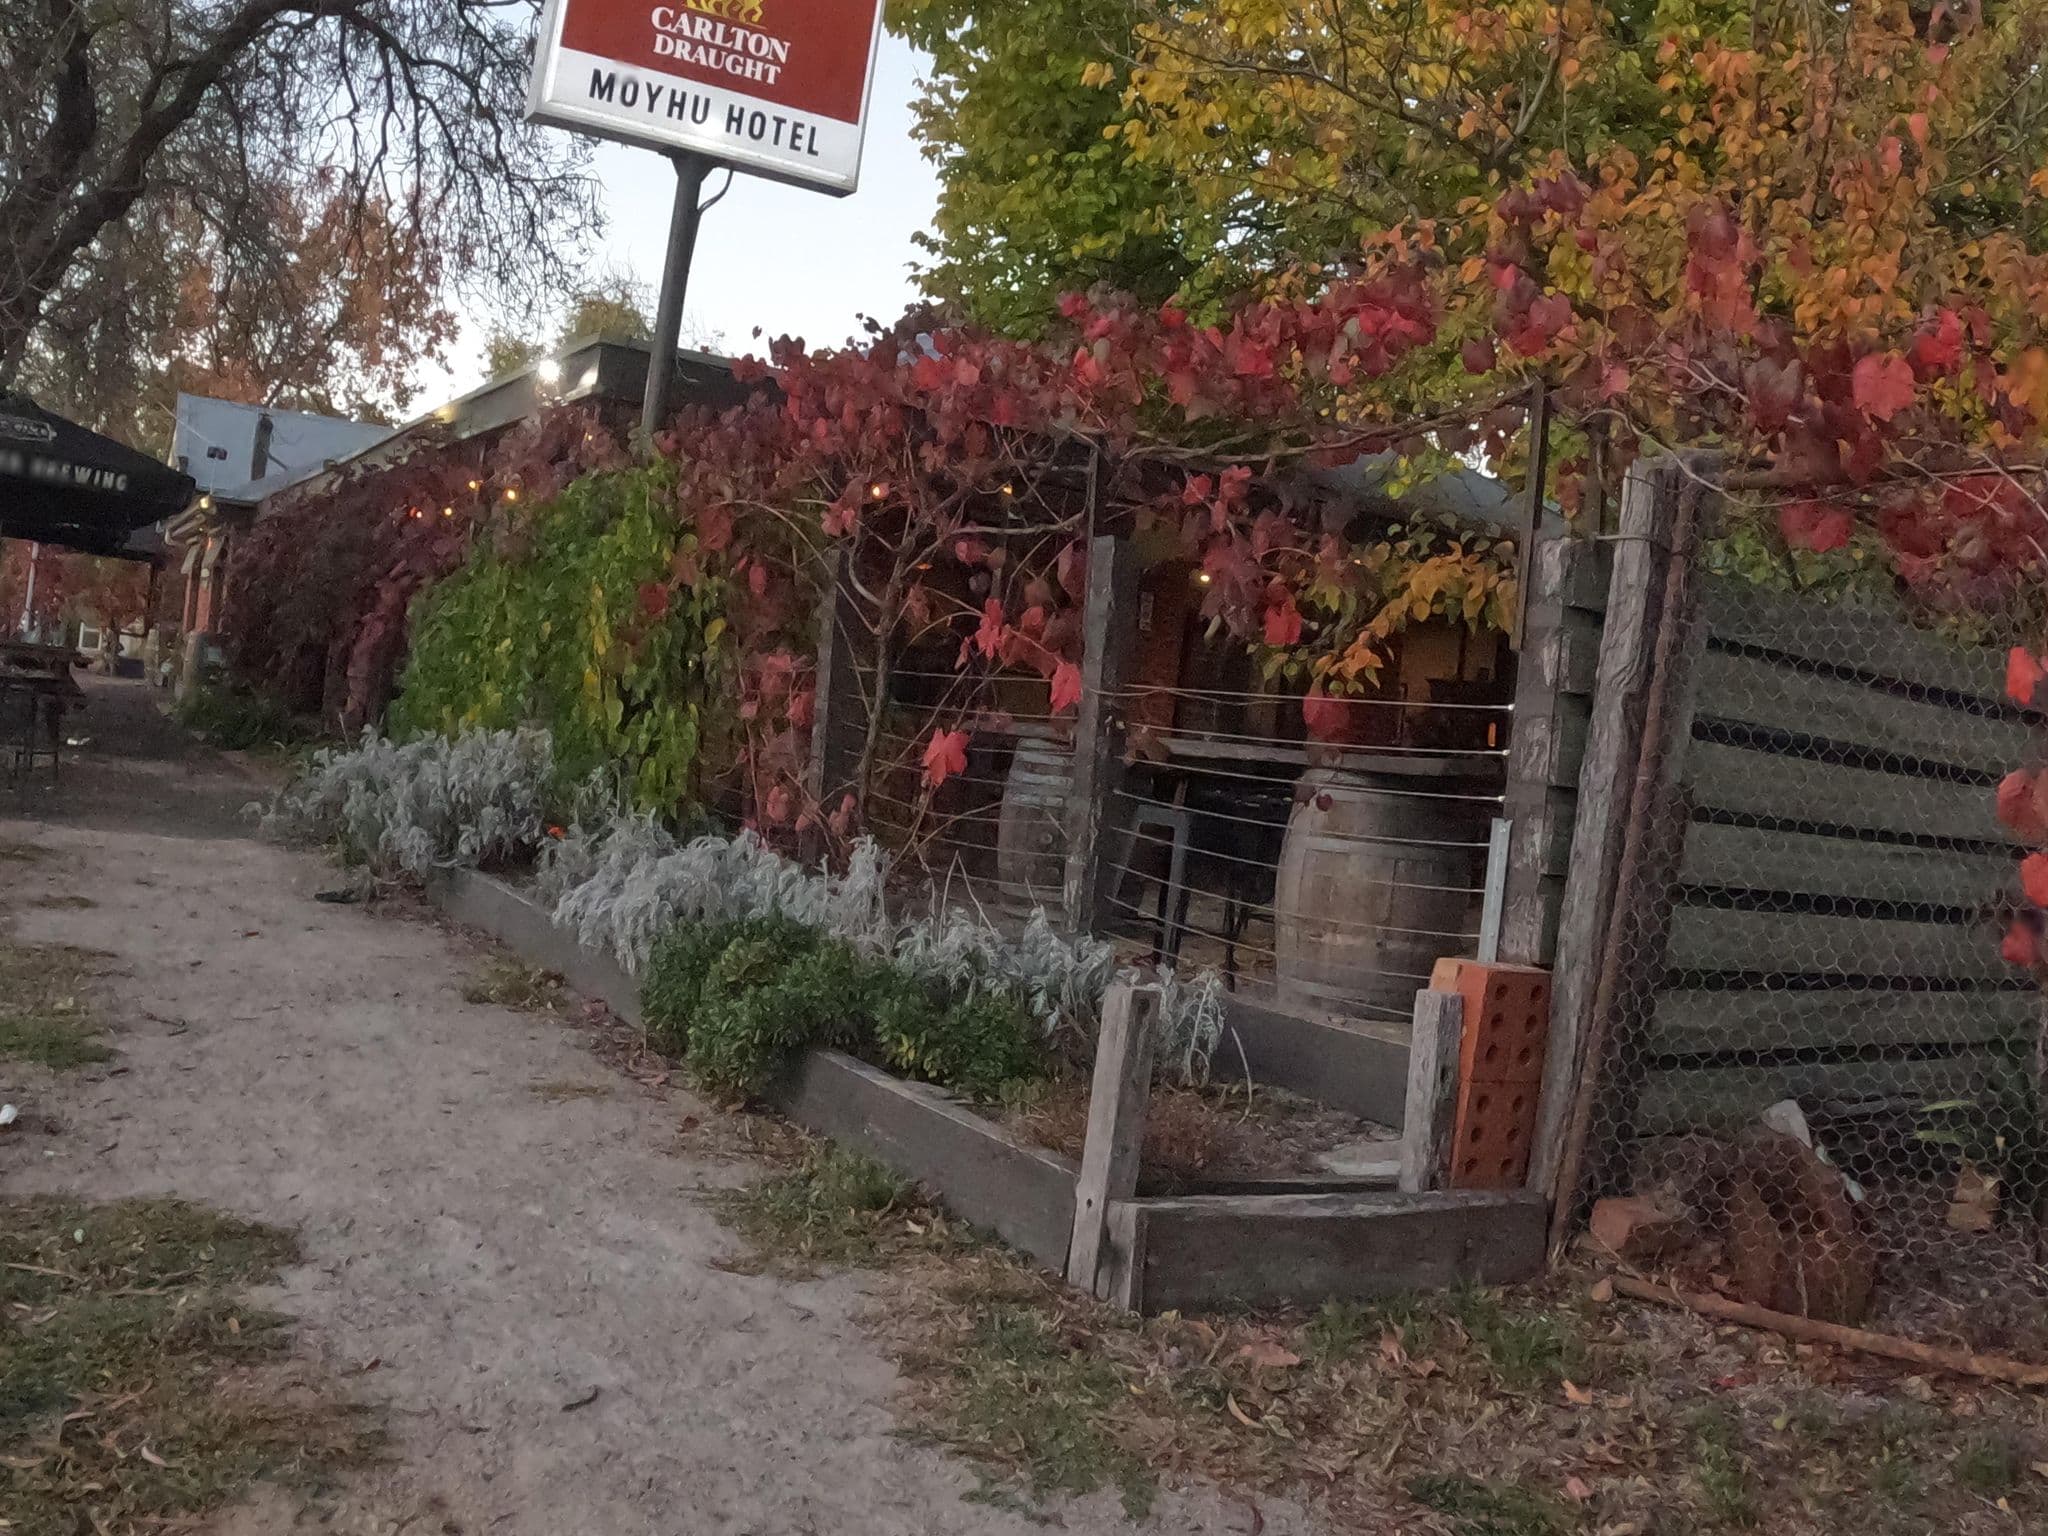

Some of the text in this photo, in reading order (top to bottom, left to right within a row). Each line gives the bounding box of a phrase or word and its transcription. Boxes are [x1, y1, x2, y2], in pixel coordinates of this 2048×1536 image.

[651, 6, 791, 64] CARLTON
[653, 33, 781, 85] DRAUGHT
[589, 68, 819, 156] MOYHU HOTEL
